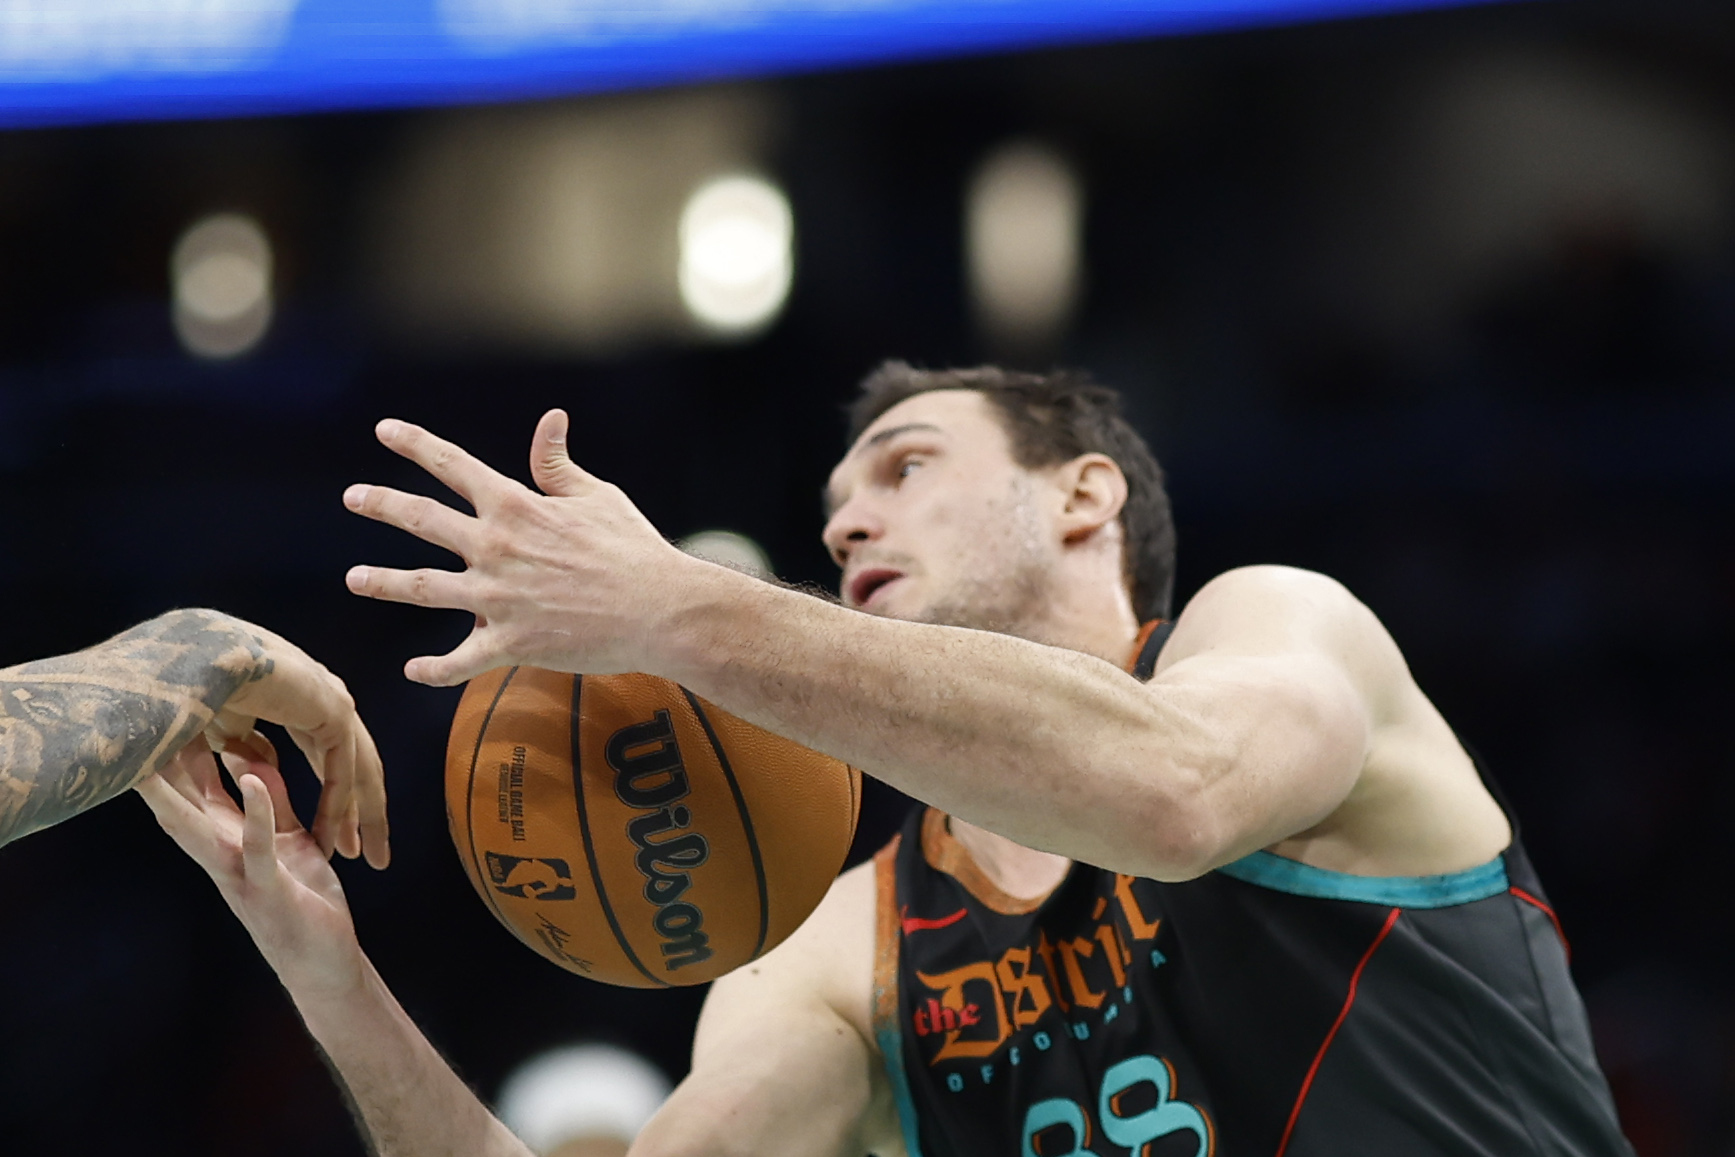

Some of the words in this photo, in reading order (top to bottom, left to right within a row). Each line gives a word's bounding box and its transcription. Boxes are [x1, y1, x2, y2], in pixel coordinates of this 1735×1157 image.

[510, 746, 526, 789] OFFICIAL
[509, 790, 524, 818] GAME
[510, 819, 526, 842] BALL
[605, 708, 715, 971] Wilson
[913, 998, 981, 1036] the
